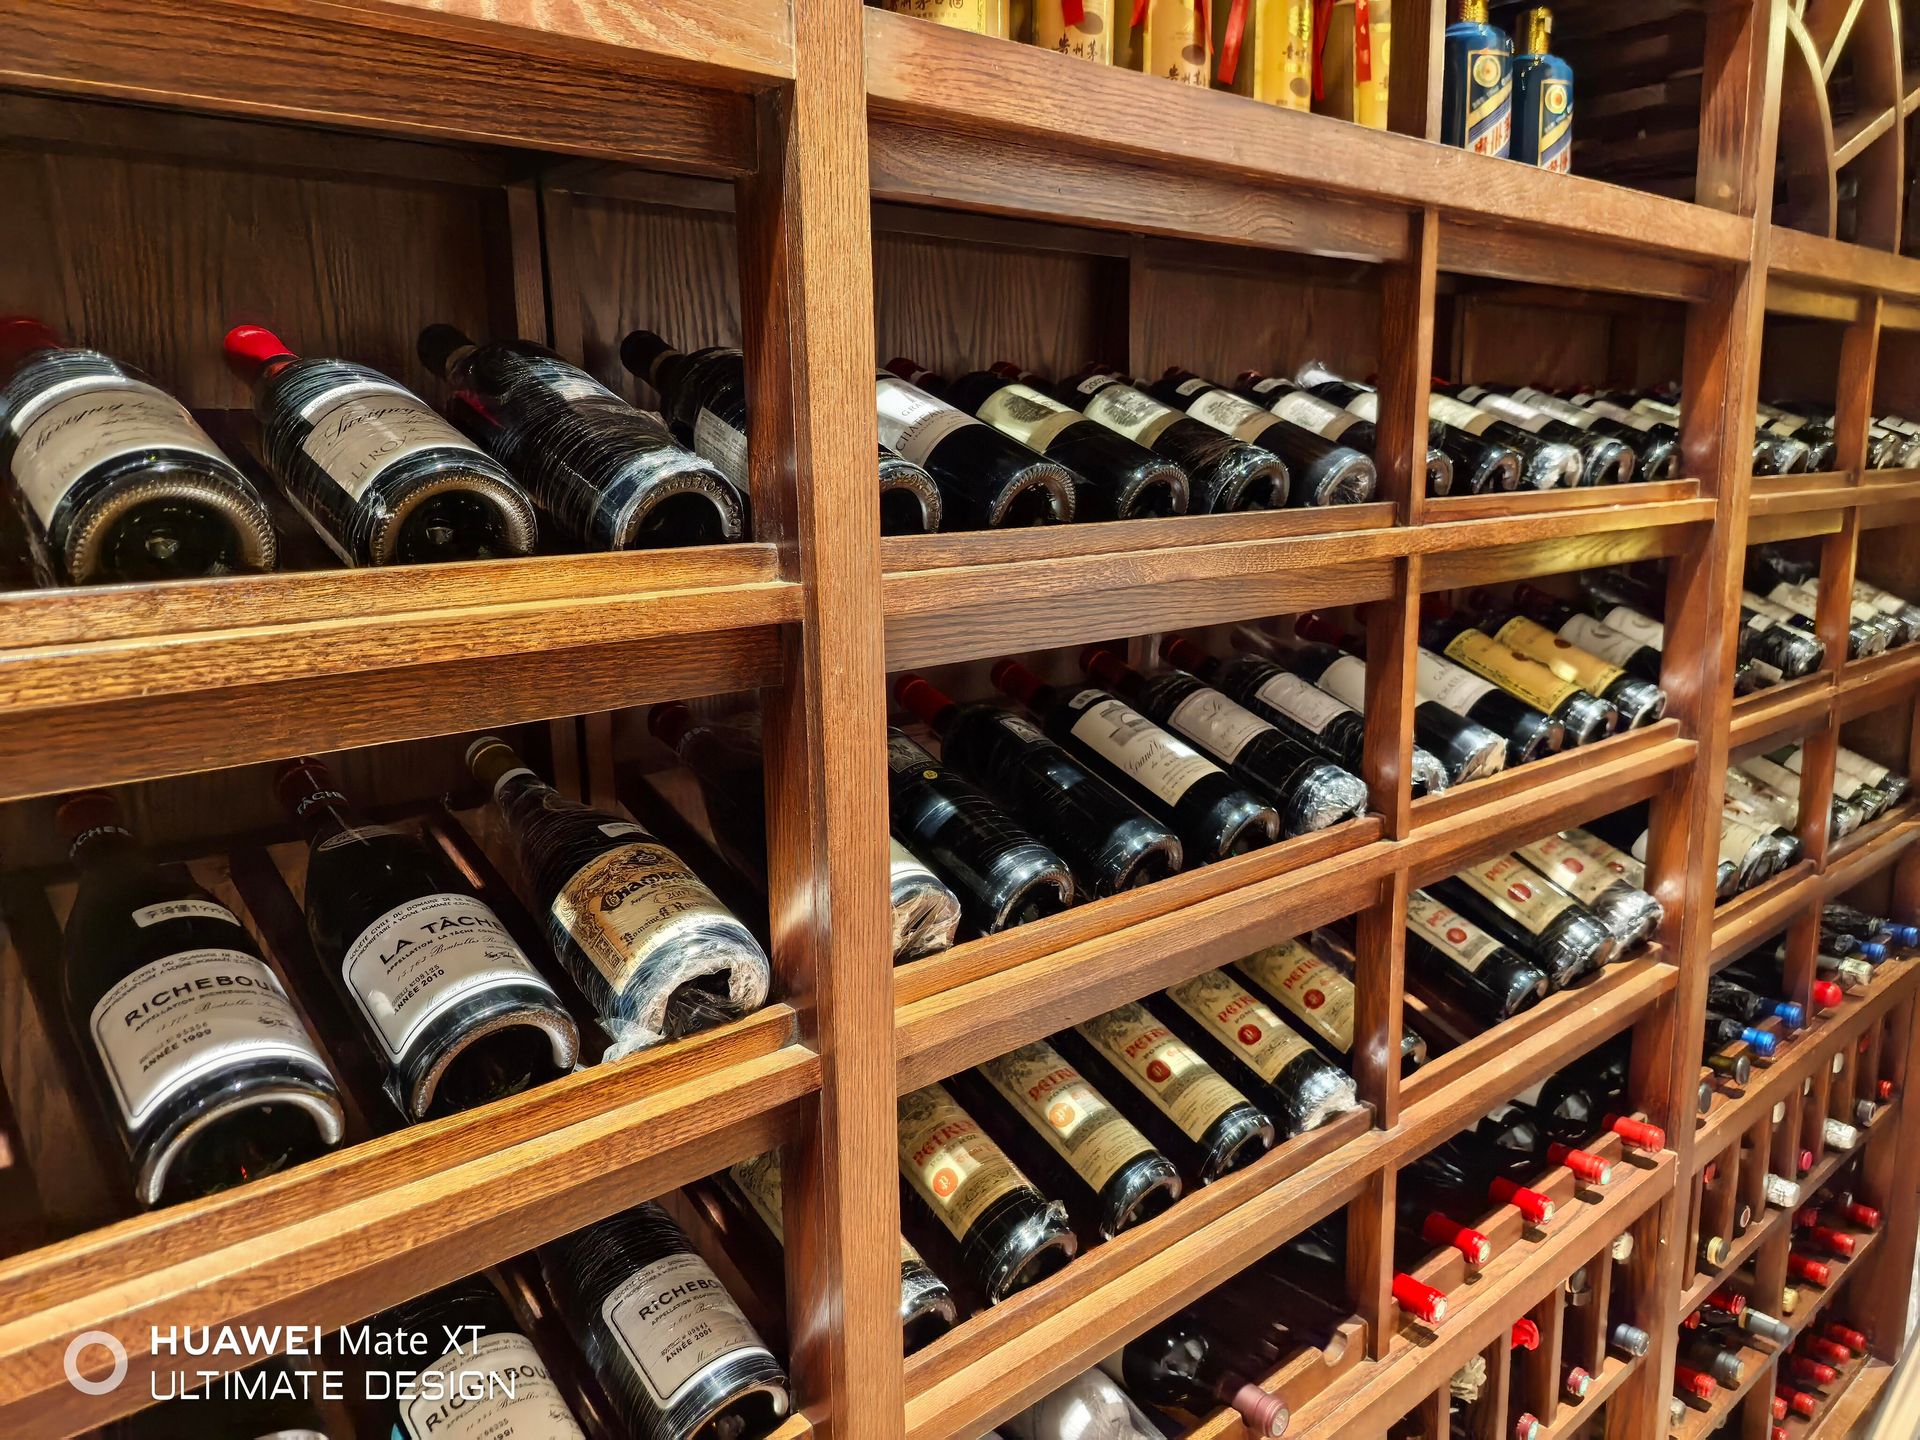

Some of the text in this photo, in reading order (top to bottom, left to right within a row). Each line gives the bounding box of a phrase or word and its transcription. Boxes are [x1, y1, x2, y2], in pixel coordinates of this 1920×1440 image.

[392, 911, 404, 919] DU
[379, 939, 414, 965] LA
[420, 916, 506, 935] TÂCHE
[386, 939, 434, 975] APPELLATION
[421, 969, 445, 987] 2010
[124, 975, 285, 1027] RICHEBOU
[143, 1043, 180, 1073] ANNÉE
[182, 1028, 212, 1044] 1999
[665, 1338, 693, 1363] ANNÉE
[694, 1327, 713, 1341] 2001
